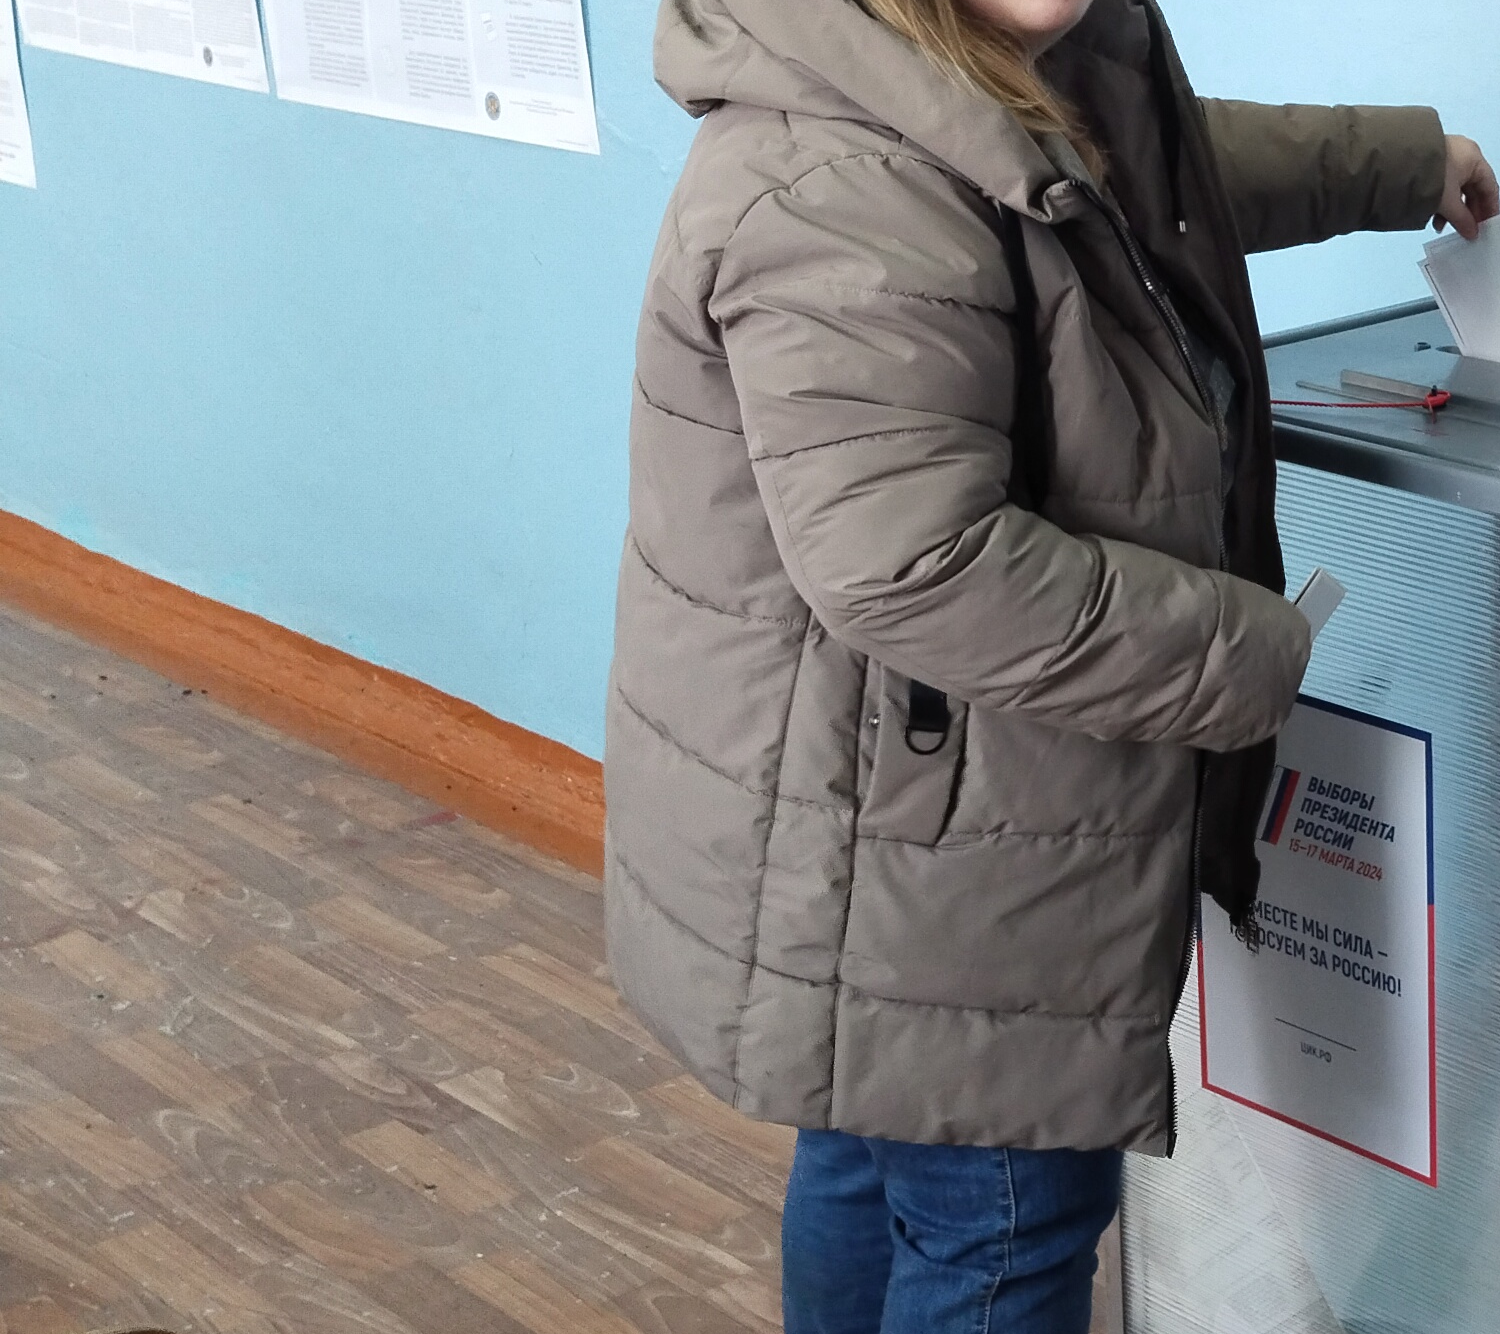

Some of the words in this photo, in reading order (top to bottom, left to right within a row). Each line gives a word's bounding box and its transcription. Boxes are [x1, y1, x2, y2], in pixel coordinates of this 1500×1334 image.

[1307, 776, 1375, 811] ВЫБОРЫ
[1294, 818, 1354, 850] РОССИИ
[1301, 797, 1395, 842] ПРЕЗИДЕНТА
[1319, 848, 1355, 872] МАРТА
[1356, 861, 1382, 881] 2024
[1249, 900, 1298, 931] МЕСТЕ
[1303, 917, 1328, 942] МЫ
[1333, 928, 1373, 959] СИЛА
[1310, 946, 1328, 969] ЗА
[1332, 954, 1401, 997] РОССИЮ!
[1300, 1042, 1332, 1063] ЦИК.РФ
